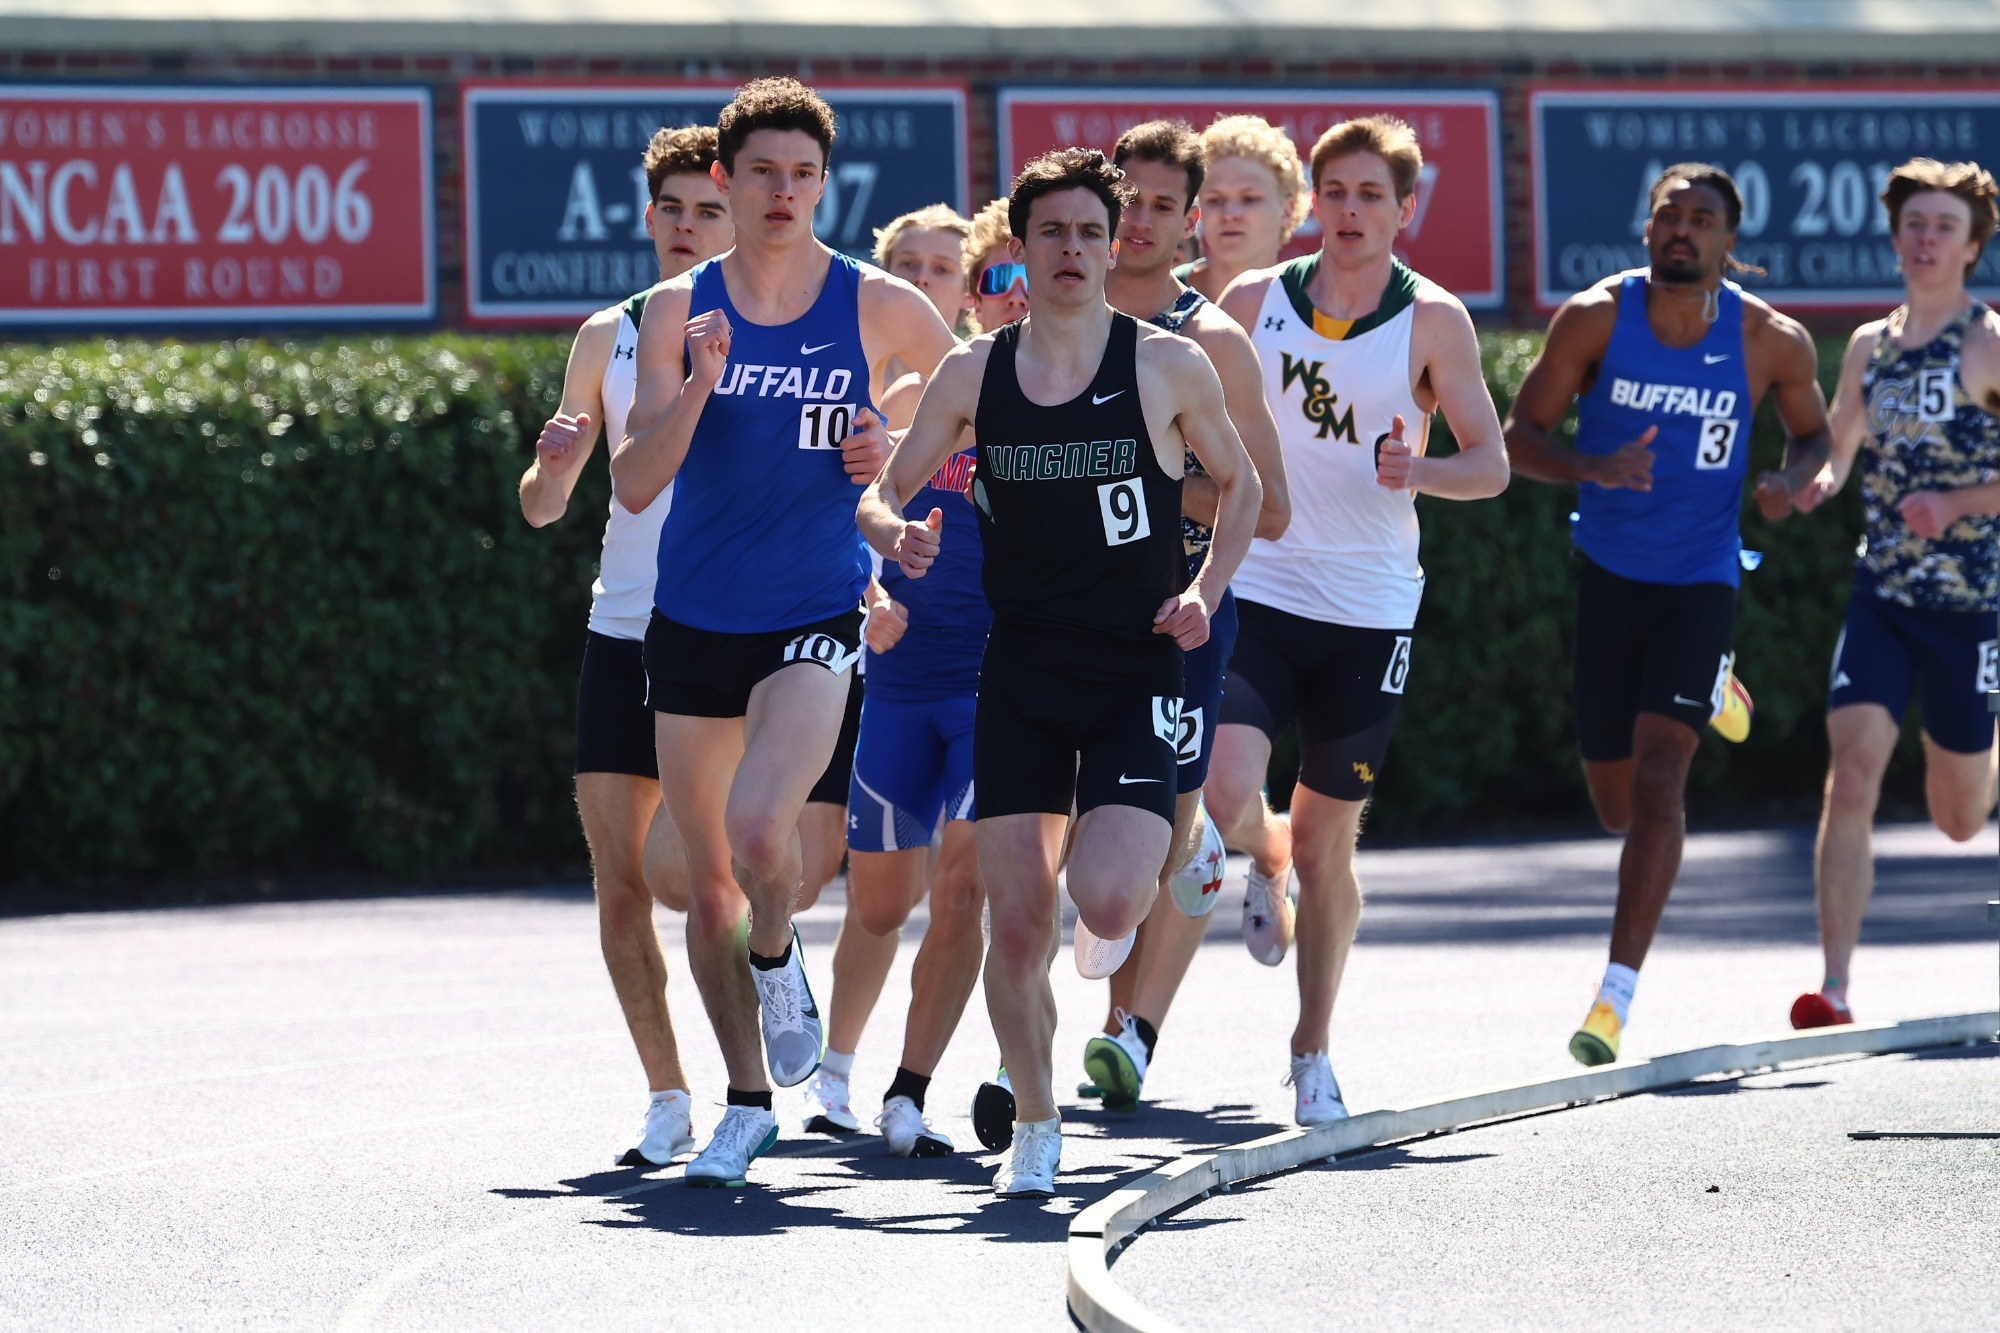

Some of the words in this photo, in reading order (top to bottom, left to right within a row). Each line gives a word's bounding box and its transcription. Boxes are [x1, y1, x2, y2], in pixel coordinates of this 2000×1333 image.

[184, 110, 379, 149] LACROSSE
[1583, 111, 1767, 149] WOMEN'S
[1783, 111, 1978, 149] LACROSSE
[0, 159, 199, 245] NCAA
[214, 157, 374, 245] 2006
[1789, 159, 1893, 237] 201
[28, 256, 161, 300] FIRST
[184, 255, 343, 300] ROUND
[713, 363, 852, 401] UFFALO
[1279, 350, 1362, 446] W&M
[1610, 377, 1737, 419] BUFFALO
[1924, 374, 1945, 415] 5
[805, 406, 849, 449] 10
[1703, 424, 1731, 464] 3
[986, 439, 1136, 481] WAGNER
[1109, 484, 1139, 540] 9
[1390, 640, 1408, 688] 6
[1160, 697, 1178, 743] 9
[1177, 716, 1197, 761] 2
